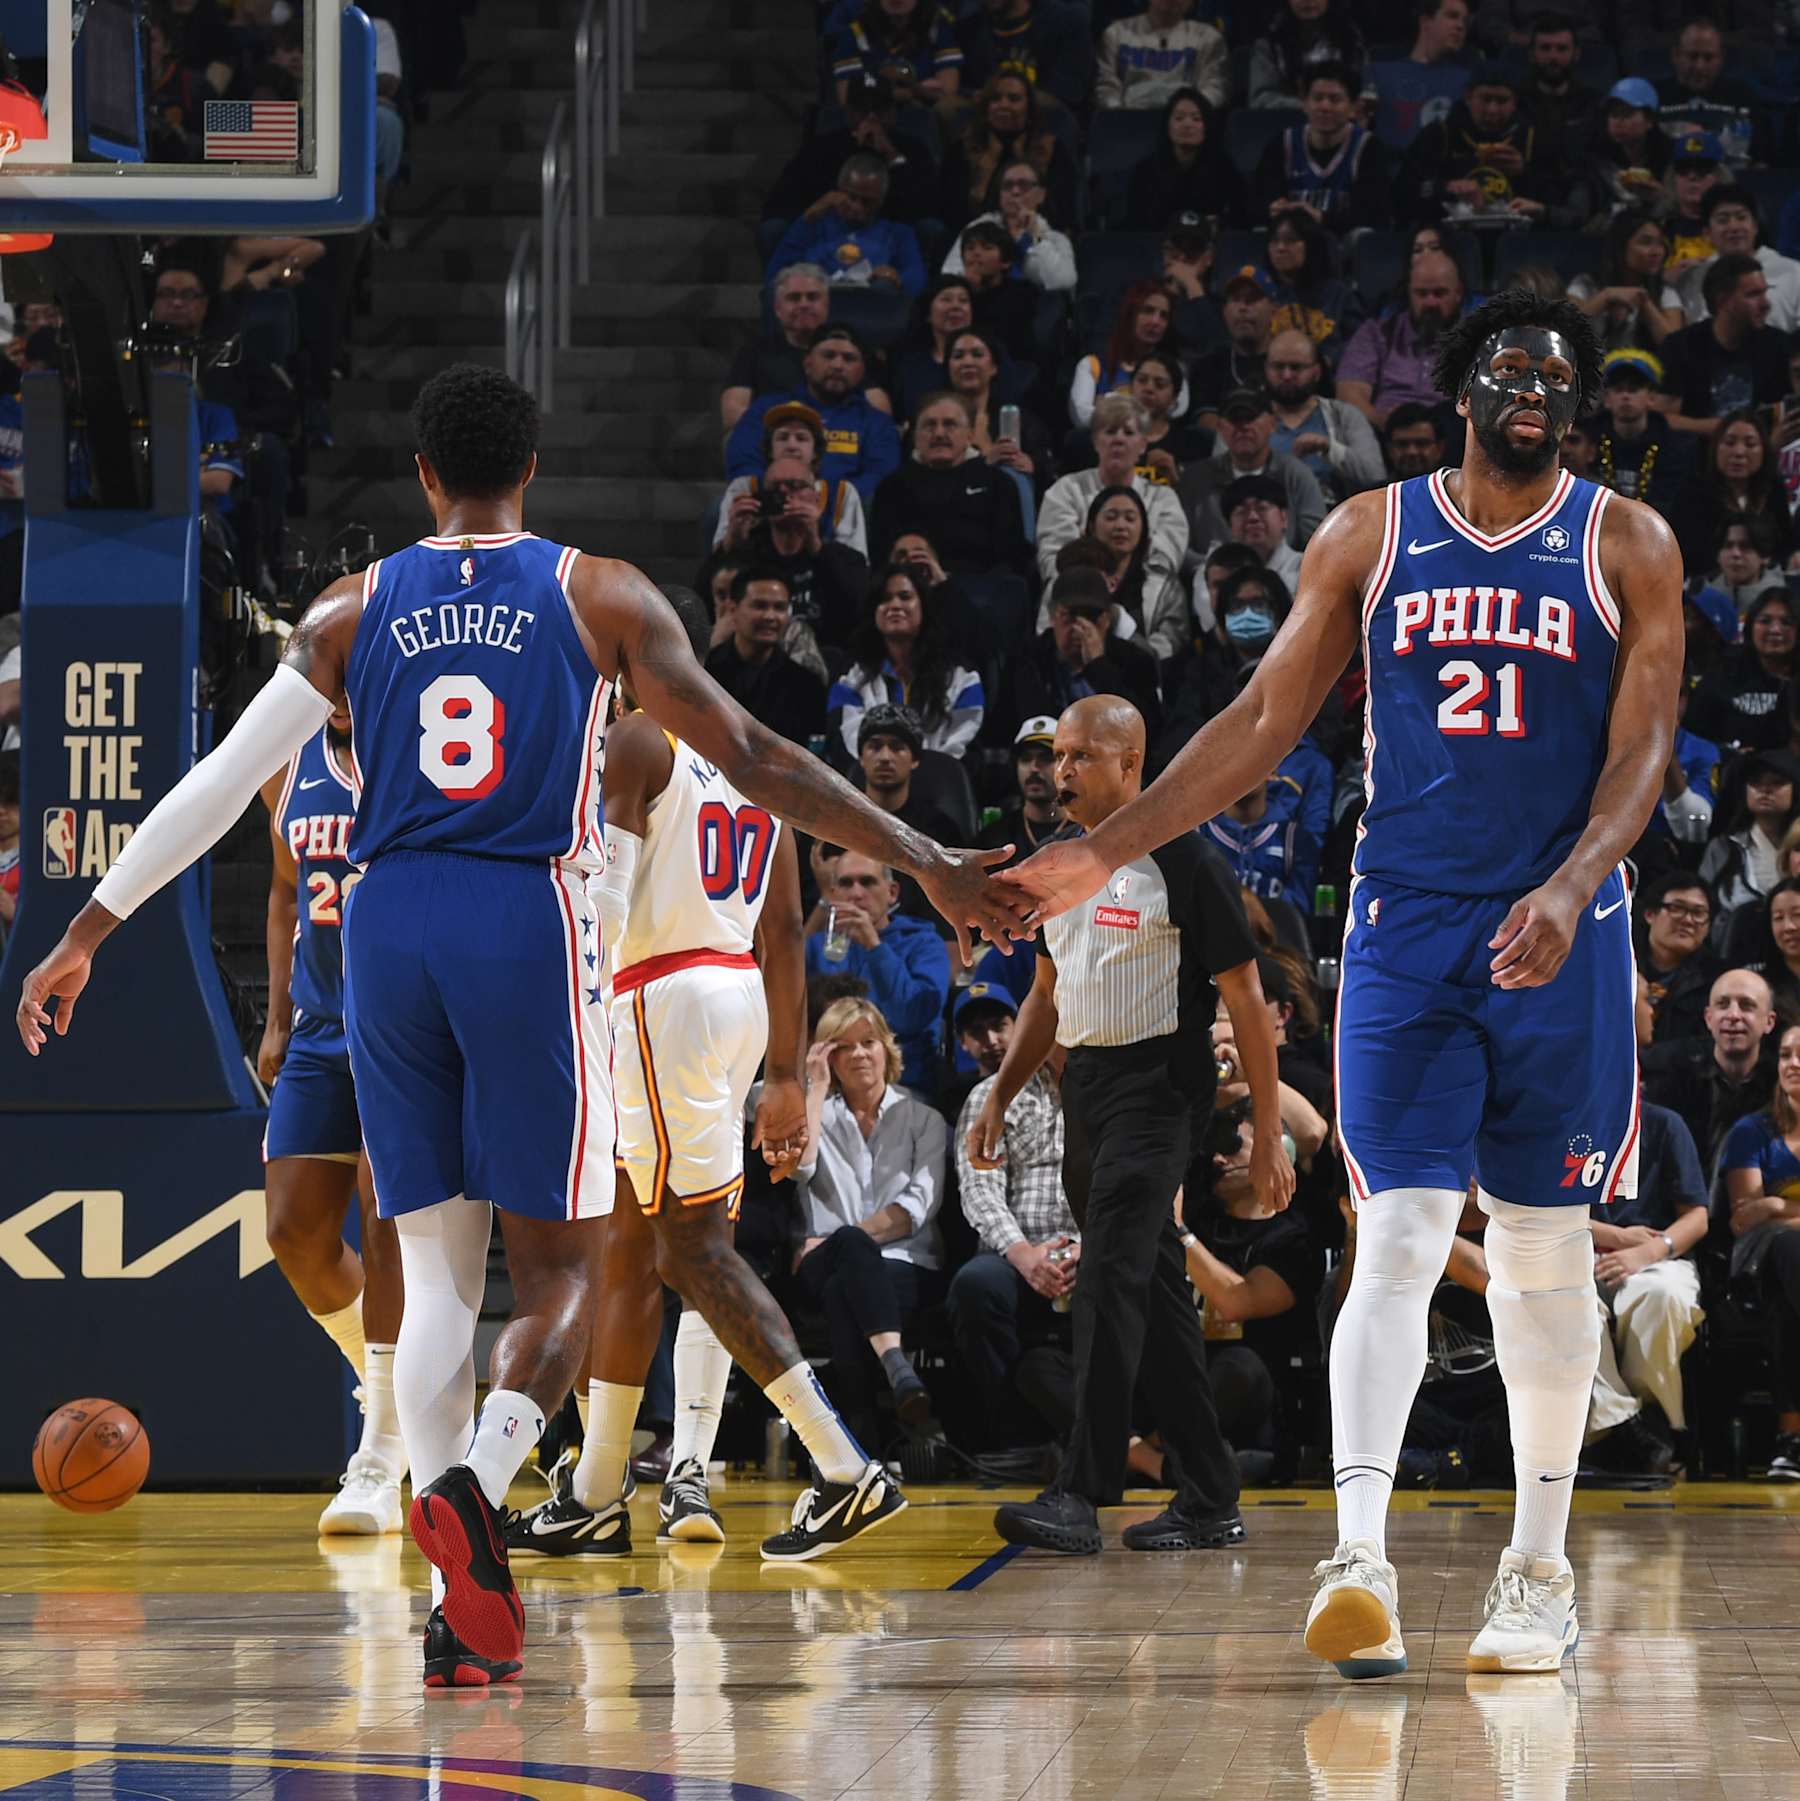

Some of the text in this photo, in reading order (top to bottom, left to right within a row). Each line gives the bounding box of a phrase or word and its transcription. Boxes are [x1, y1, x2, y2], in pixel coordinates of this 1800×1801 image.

[1528, 553, 1579, 565] crypto.com
[390, 604, 535, 659] GEORGE
[1392, 586, 1577, 663] PHILA
[65, 662, 142, 728] GET
[1437, 660, 1526, 738] 21
[63, 736, 142, 800] THE
[419, 675, 505, 800] 8
[288, 814, 356, 864] PHI
[698, 802, 776, 905] 00
[1095, 909, 1138, 926] Emirates
[1559, 1150, 1607, 1188] 76
